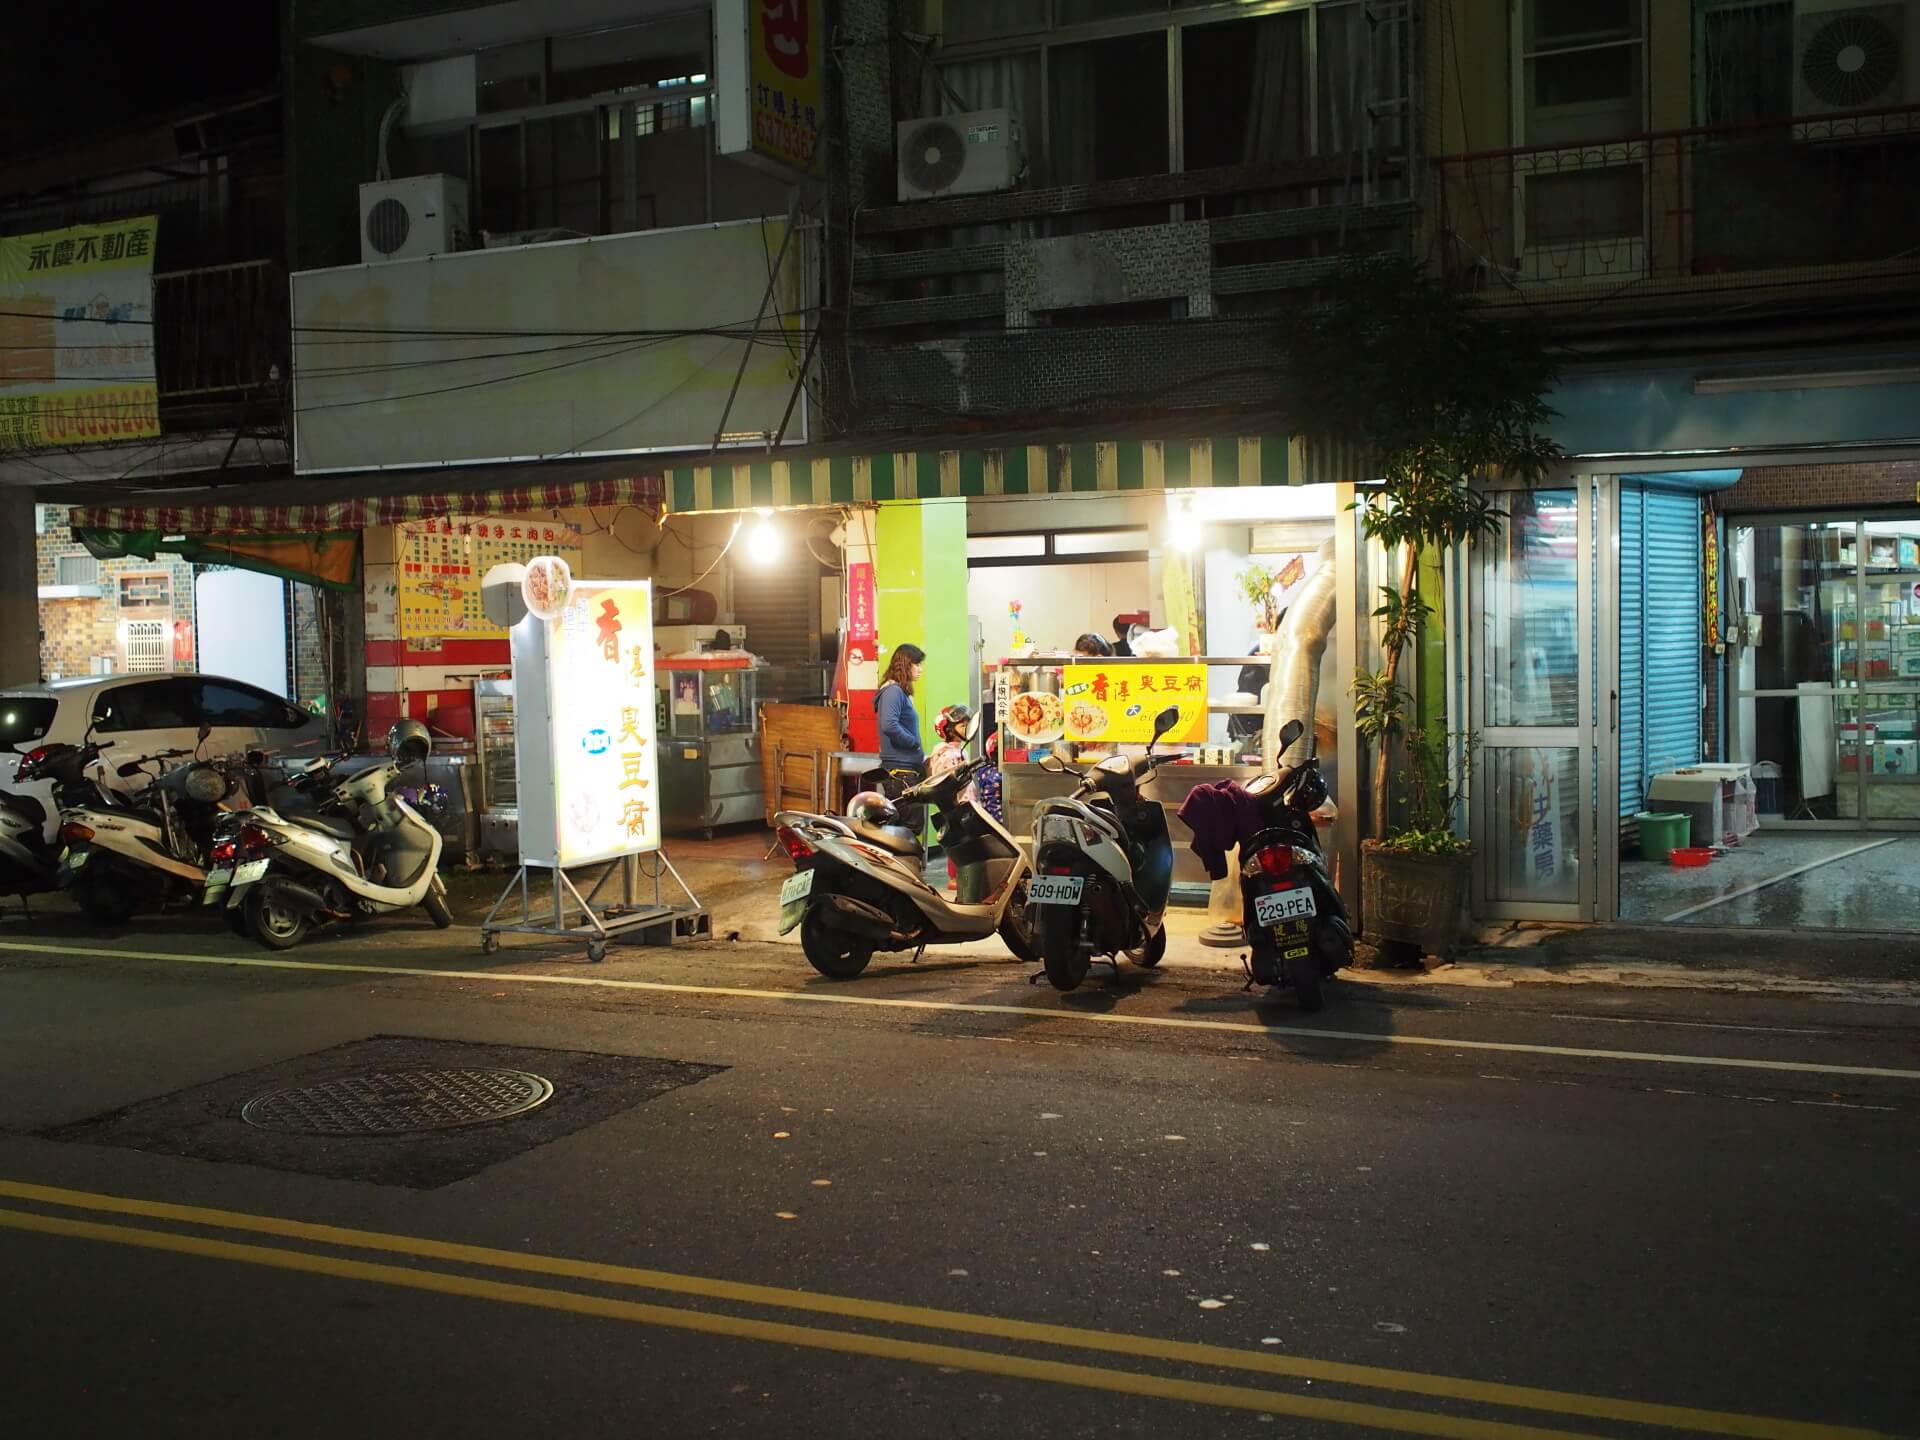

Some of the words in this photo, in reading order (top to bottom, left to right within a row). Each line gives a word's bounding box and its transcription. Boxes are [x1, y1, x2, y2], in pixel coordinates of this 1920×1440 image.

[28, 228, 151, 271] 永慶不動產
[1091, 673, 1204, 702] 香淳臭豆腐
[1030, 884, 1081, 901] 509-HDW
[1258, 897, 1314, 922] 229-PEA
